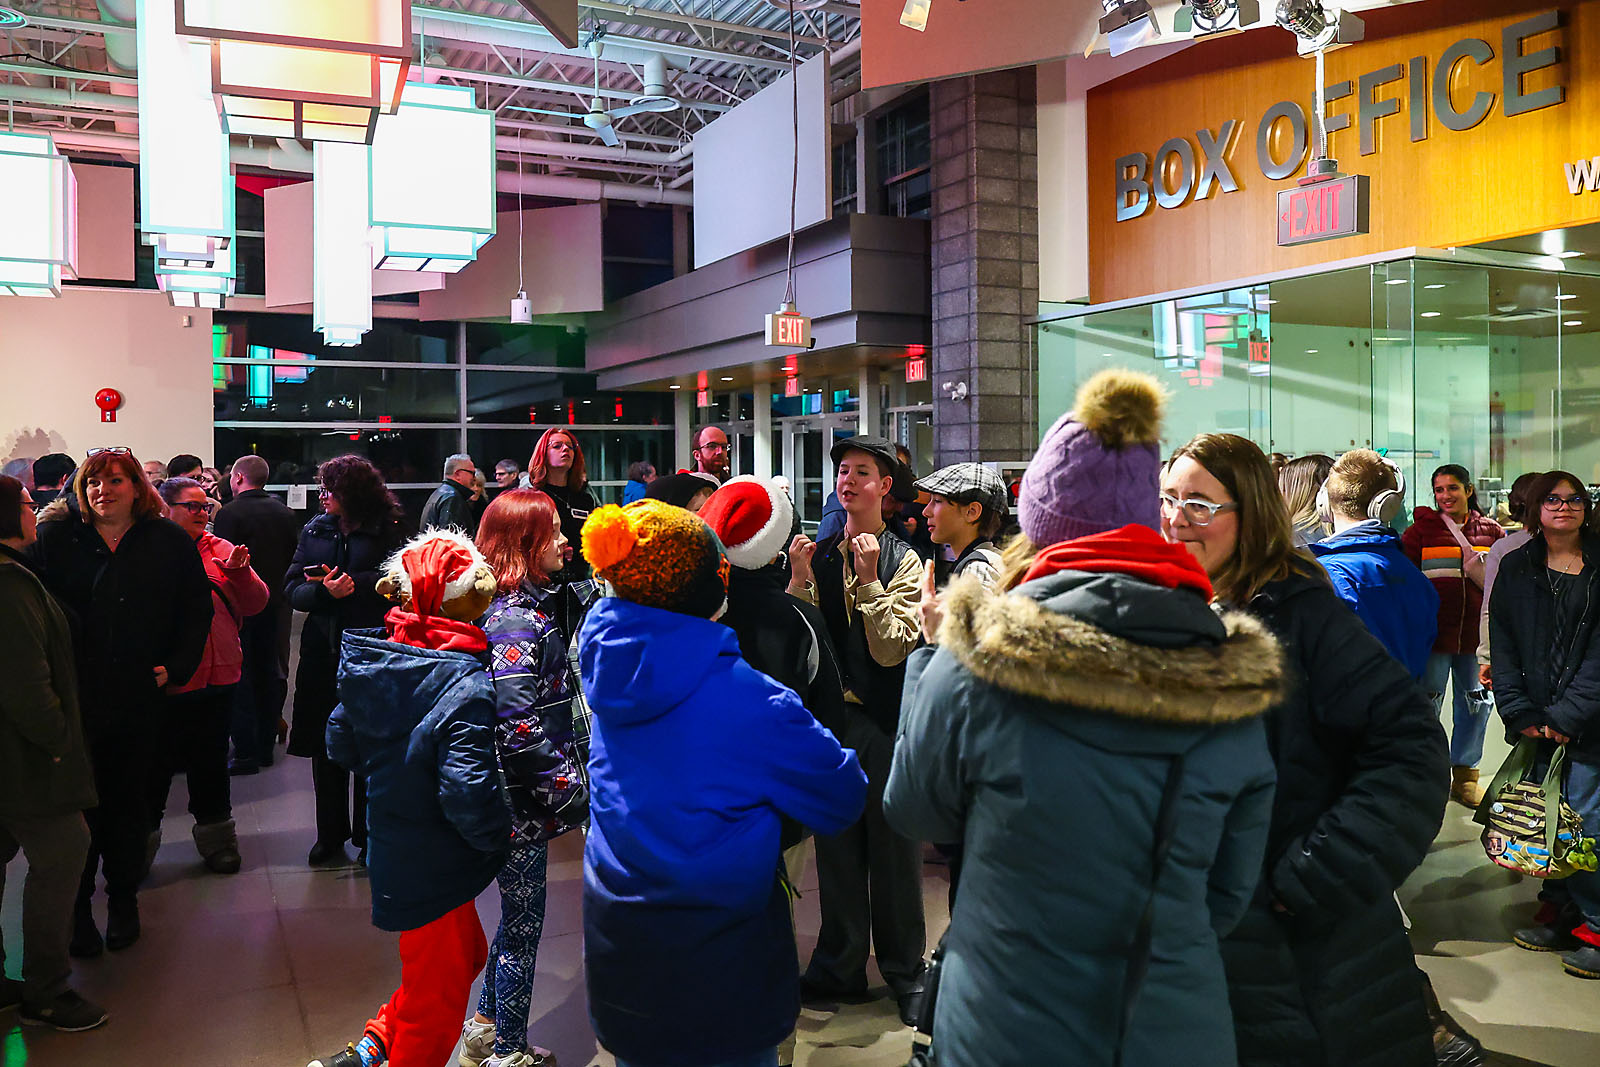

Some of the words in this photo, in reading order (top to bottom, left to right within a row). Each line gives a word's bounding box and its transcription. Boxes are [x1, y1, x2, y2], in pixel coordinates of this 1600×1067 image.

[1115, 119, 1239, 222] BOX
[1257, 9, 1565, 179] OFFICE
[1563, 155, 1600, 194] W
[1290, 184, 1344, 238] EXIT
[777, 317, 804, 344] EXIT
[909, 360, 924, 381] EXIT
